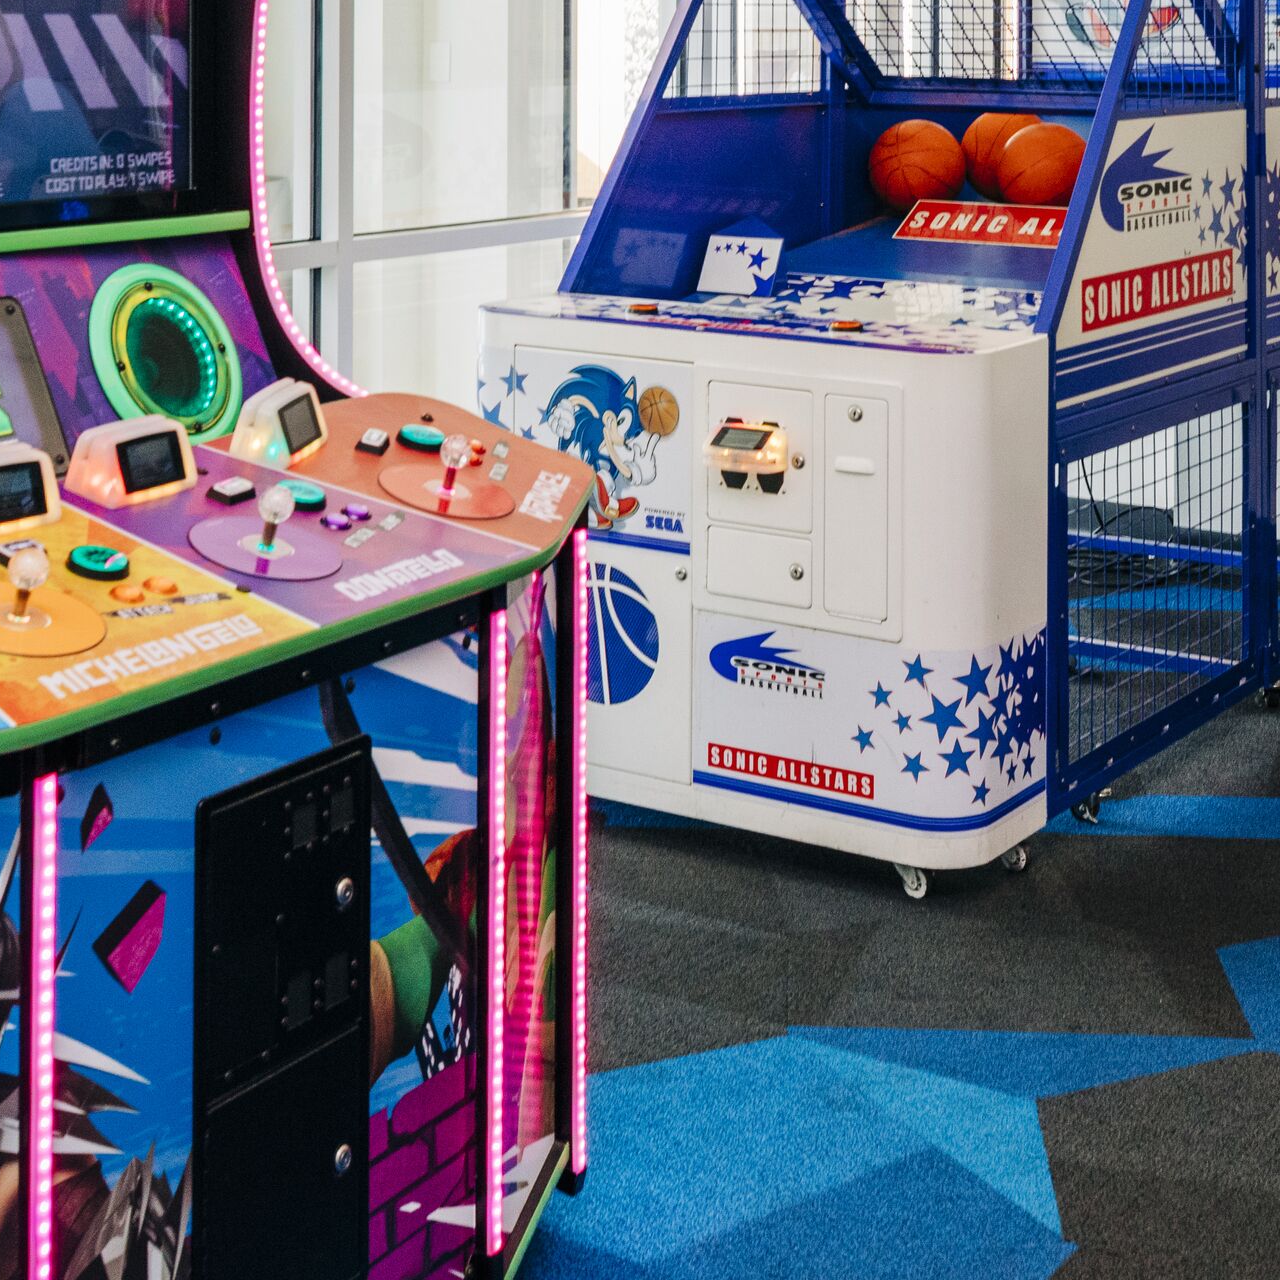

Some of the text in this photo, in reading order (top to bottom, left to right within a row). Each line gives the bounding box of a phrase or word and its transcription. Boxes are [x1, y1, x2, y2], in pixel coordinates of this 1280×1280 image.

[51, 154, 97, 173] CREDITS
[128, 150, 173, 168] SWIPES
[45, 176, 79, 194] COST
[79, 174, 93, 192] TO
[138, 168, 176, 186] SWIPE
[1120, 178, 1192, 201] SONIC
[1126, 193, 1191, 213] SPORTS
[908, 210, 1009, 234] SONIC
[1126, 209, 1191, 232] BASKETBALL
[1084, 255, 1231, 325] SONIC ALLSTARS
[645, 515, 684, 534] SEGA
[38, 613, 264, 700] MICHELANGELO
[733, 658, 826, 682] SONIC
[741, 678, 823, 700] BASKETBALL
[711, 746, 871, 796] SONIC ALLSTARS
